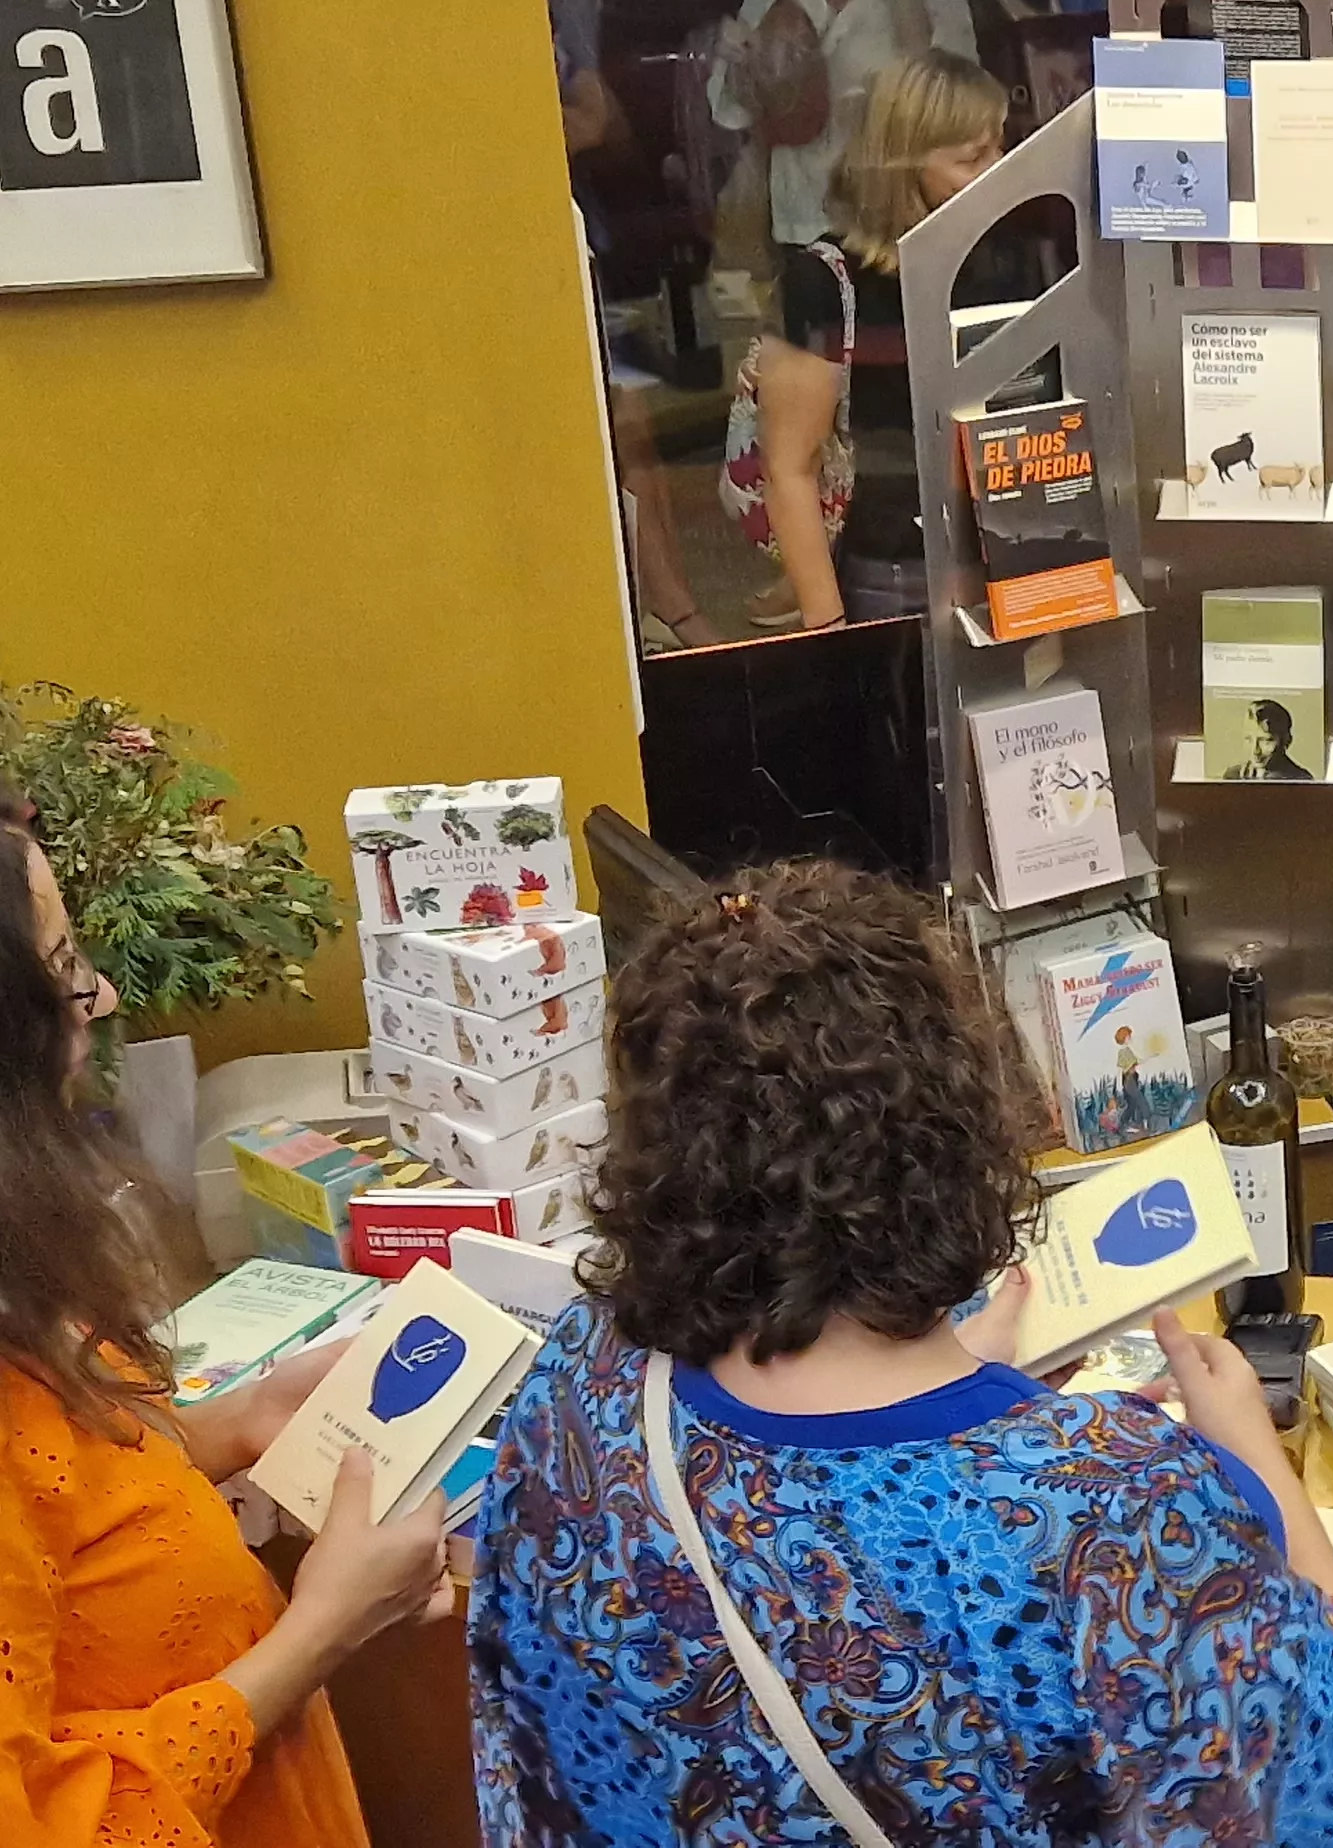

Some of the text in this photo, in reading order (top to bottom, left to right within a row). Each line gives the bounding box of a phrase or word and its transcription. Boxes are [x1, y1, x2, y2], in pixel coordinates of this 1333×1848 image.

[15, 27, 104, 156] a
[1191, 322, 1269, 337] Cómo no ser
[1192, 337, 1257, 349] un esclavo
[1192, 348, 1264, 362] del sistema
[983, 440, 1009, 466] EL
[1016, 430, 1067, 460] DIOS
[986, 450, 1092, 491] DE PIEDRA
[995, 720, 1059, 745] El mono
[999, 728, 1088, 764] y el filósofo
[405, 846, 513, 862] ENCUENTRA
[424, 861, 497, 876] LA HOJA
[226, 1278, 250, 1290] EL
[241, 1267, 347, 1292] AVISTA
